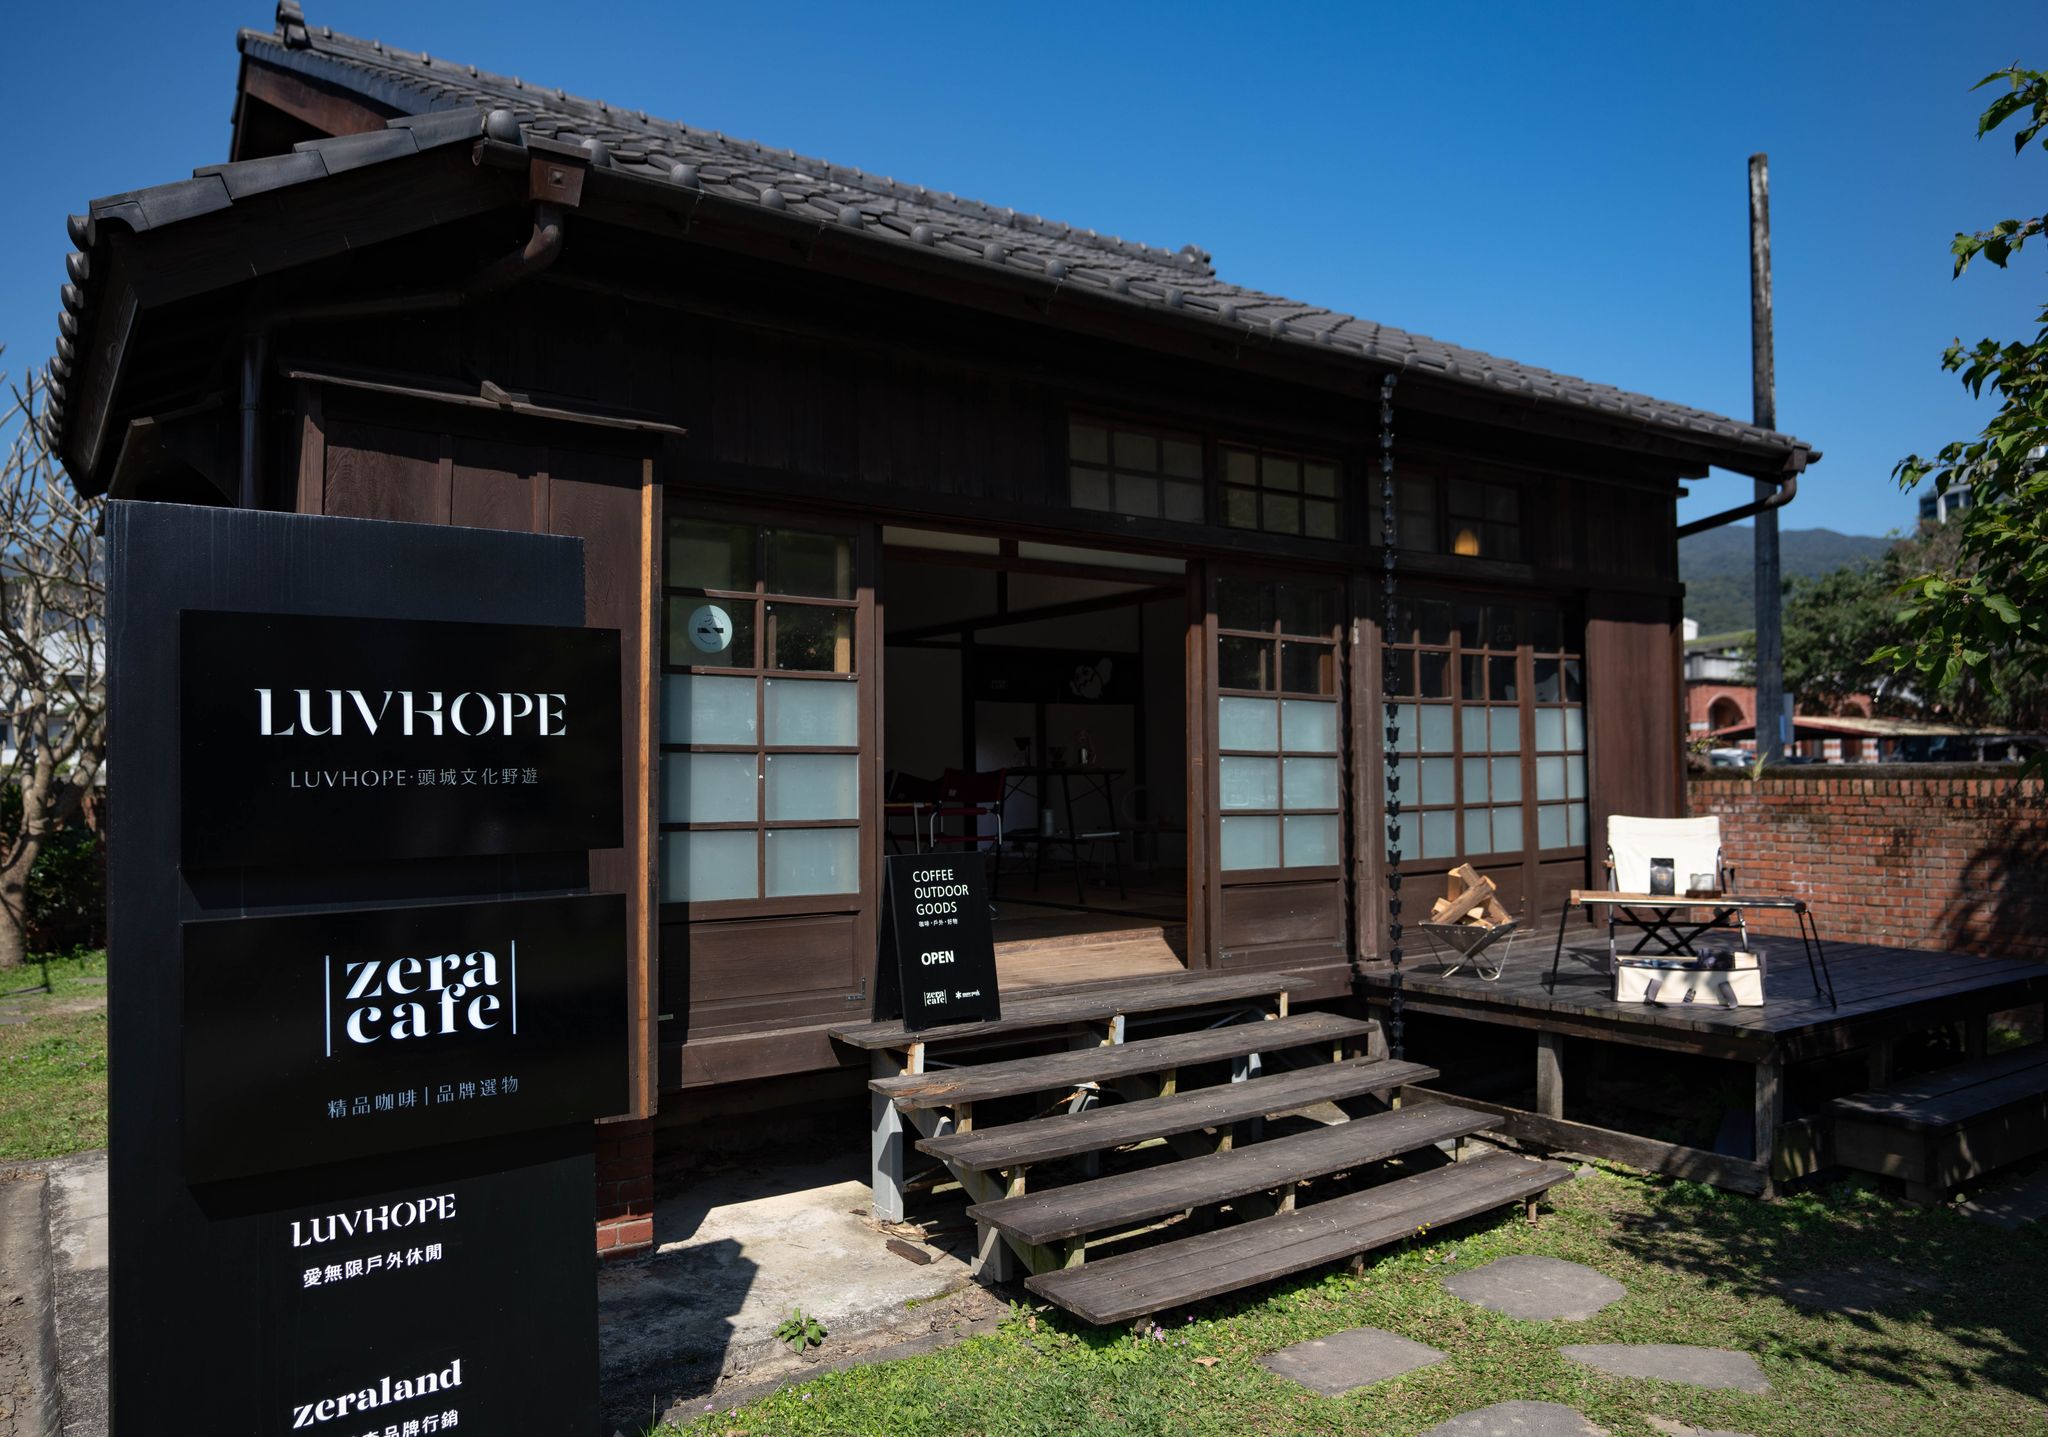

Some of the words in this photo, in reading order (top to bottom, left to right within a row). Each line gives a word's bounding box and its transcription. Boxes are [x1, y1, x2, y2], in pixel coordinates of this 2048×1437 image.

[254, 688, 567, 737] LUVHOPE
[912, 868, 955, 883] COFFEE
[914, 884, 970, 899] OUTDOOR
[915, 901, 958, 916] GOODS
[345, 951, 502, 1000] zera
[920, 949, 955, 966] OPEN
[346, 983, 501, 1044] cafe
[291, 1193, 457, 1248] LUVHOPE
[292, 1358, 463, 1429] zeraland
